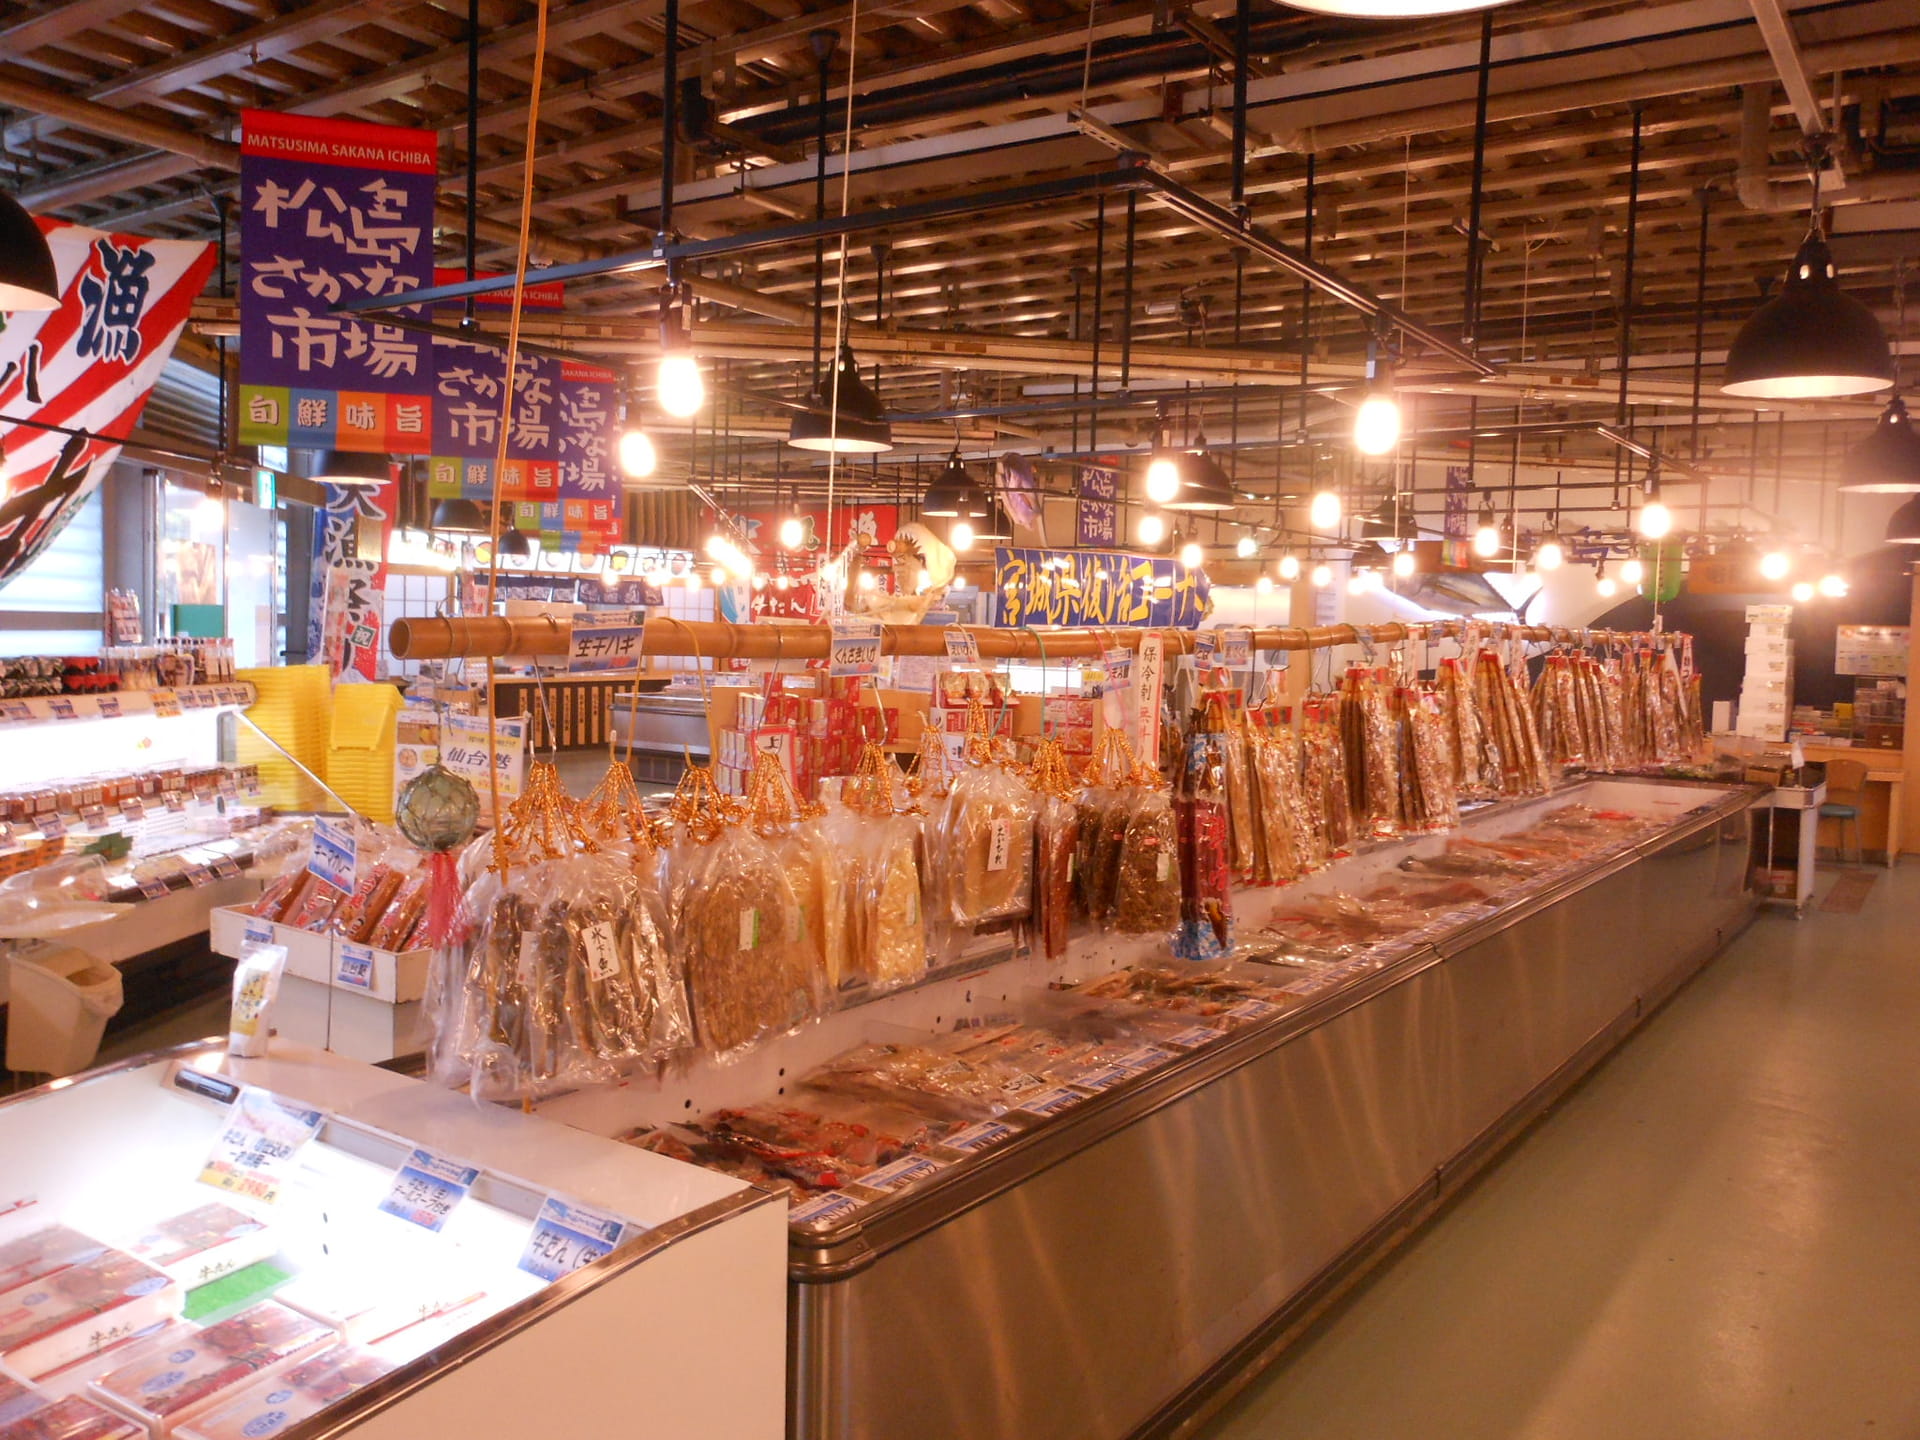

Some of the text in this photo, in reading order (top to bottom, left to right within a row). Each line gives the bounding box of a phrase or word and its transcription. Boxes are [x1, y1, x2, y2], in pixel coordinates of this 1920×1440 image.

[248, 134, 431, 166] MATSUSIMA SAKANA ICHIBA
[250, 255, 421, 314] さかな
[490, 288, 528, 299] SAKAA
[267, 307, 419, 379] 市場
[438, 367, 552, 404] さかな
[448, 402, 550, 450] 市場
[1083, 515, 1113, 540] 市場
